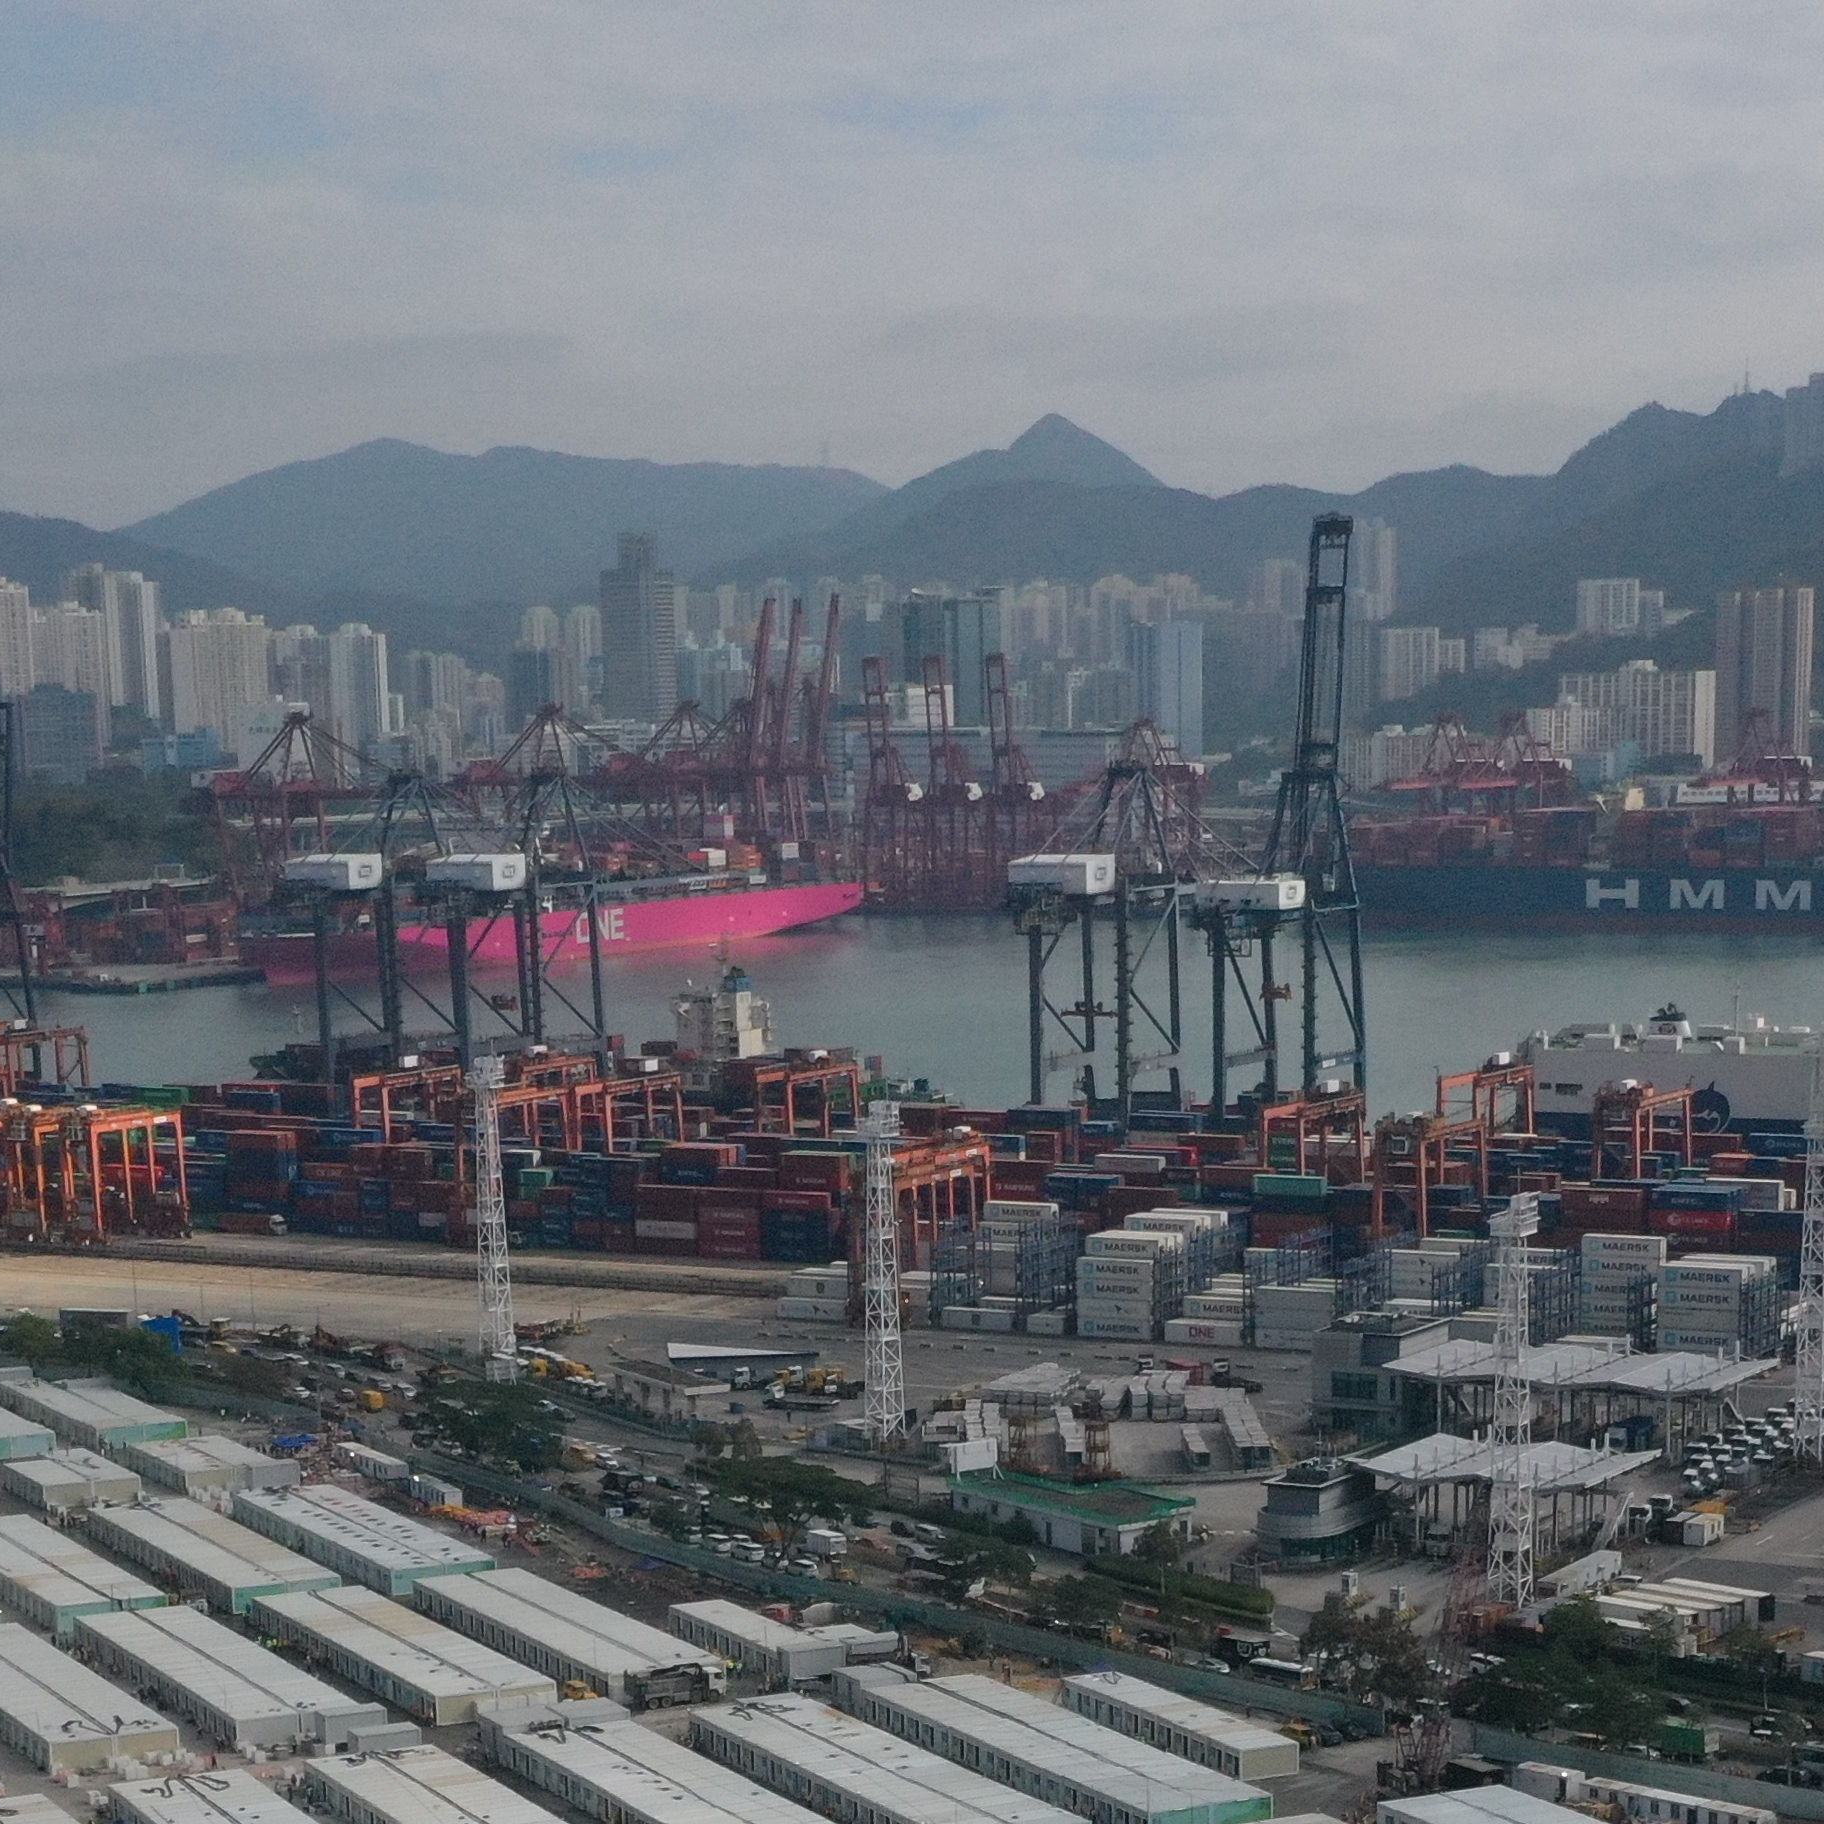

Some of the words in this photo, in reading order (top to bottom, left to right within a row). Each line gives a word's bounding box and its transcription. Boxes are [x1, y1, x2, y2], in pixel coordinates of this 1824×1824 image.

[1584, 877, 1813, 912] HMM
[576, 907, 625, 944] ONE
[1001, 1207, 1042, 1218] MAERSK
[1143, 1222, 1185, 1233] MAERSK
[1104, 1242, 1148, 1254] MAERSK
[1602, 1243, 1650, 1253] MAERSK
[1095, 1264, 1140, 1275] MAERSK
[1601, 1262, 1648, 1273] MAERSK
[1679, 1271, 1731, 1285] MAERSK
[1095, 1283, 1140, 1295] MAERSK
[1679, 1292, 1731, 1305] MAERSK
[1095, 1321, 1140, 1334] MAERSK
[1188, 1326, 1215, 1339] ONE
[1679, 1335, 1730, 1346] MAERSK
